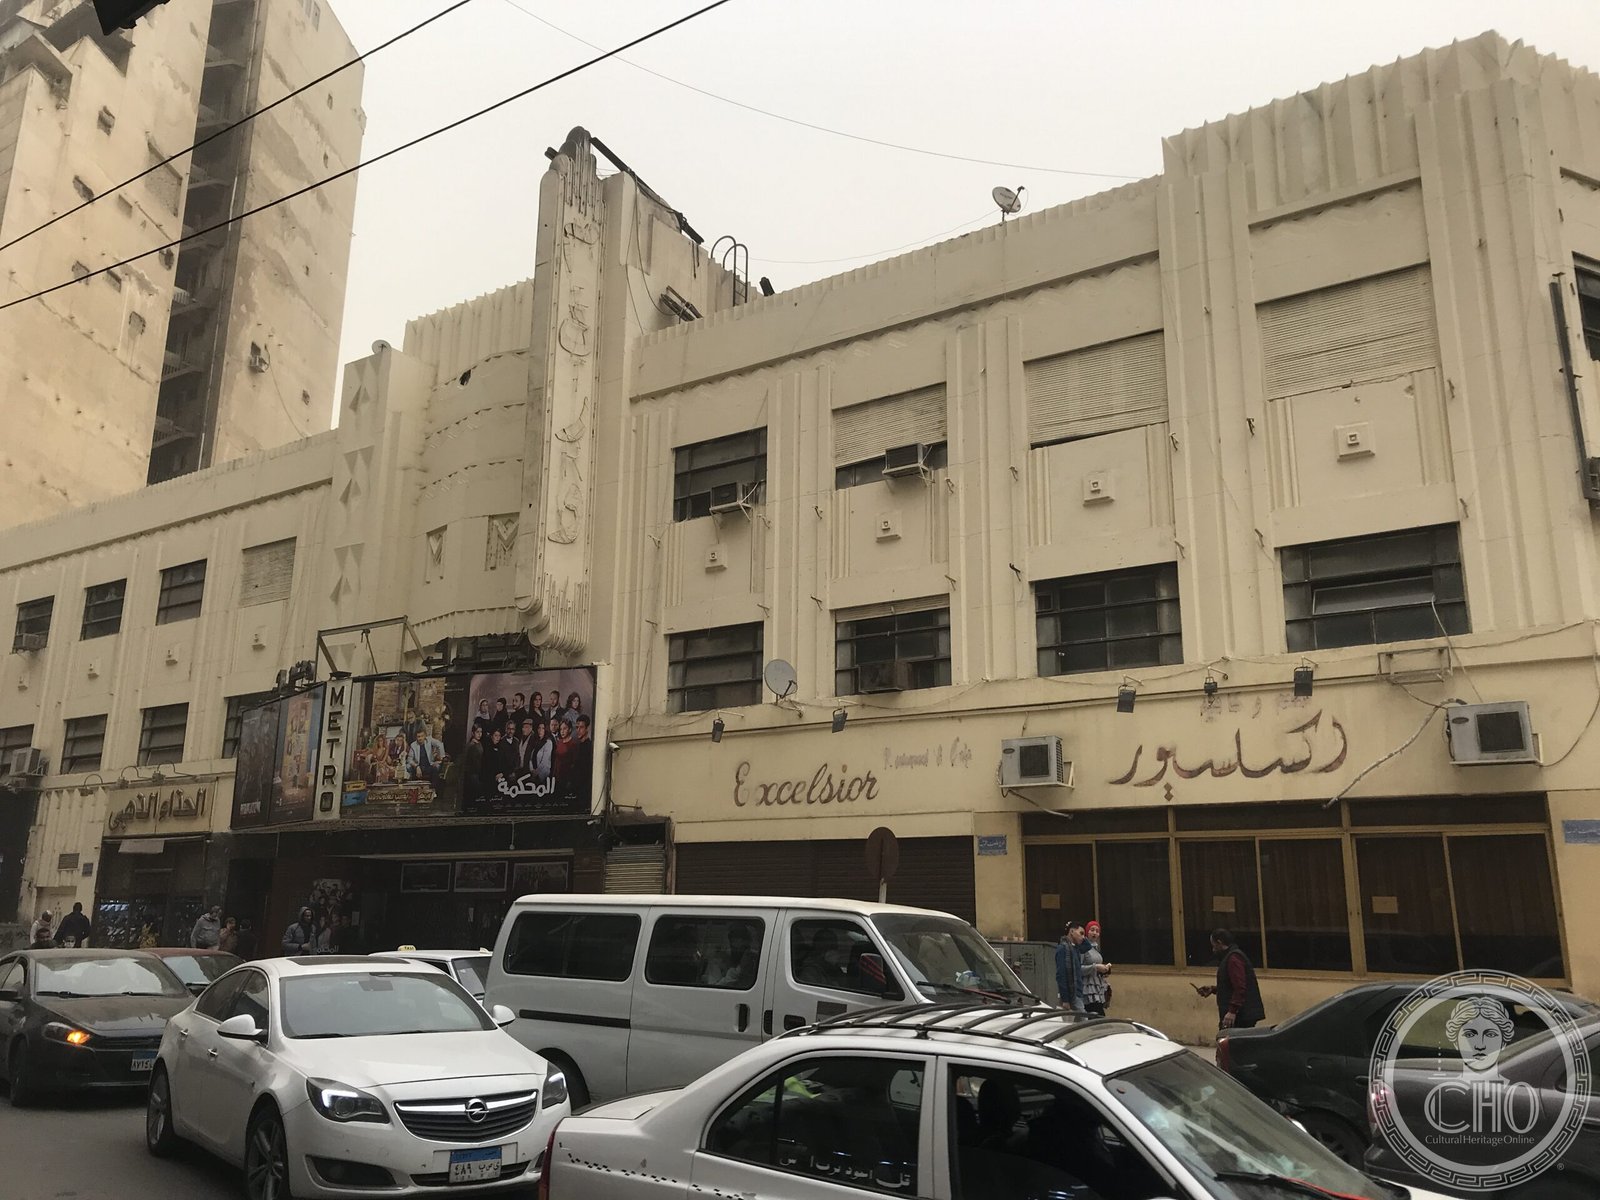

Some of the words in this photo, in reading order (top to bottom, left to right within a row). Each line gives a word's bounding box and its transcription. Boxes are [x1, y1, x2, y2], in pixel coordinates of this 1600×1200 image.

[319, 685, 345, 813] METRO
[496, 772, 555, 798] المحكمة
[733, 761, 879, 807] Excelsior
